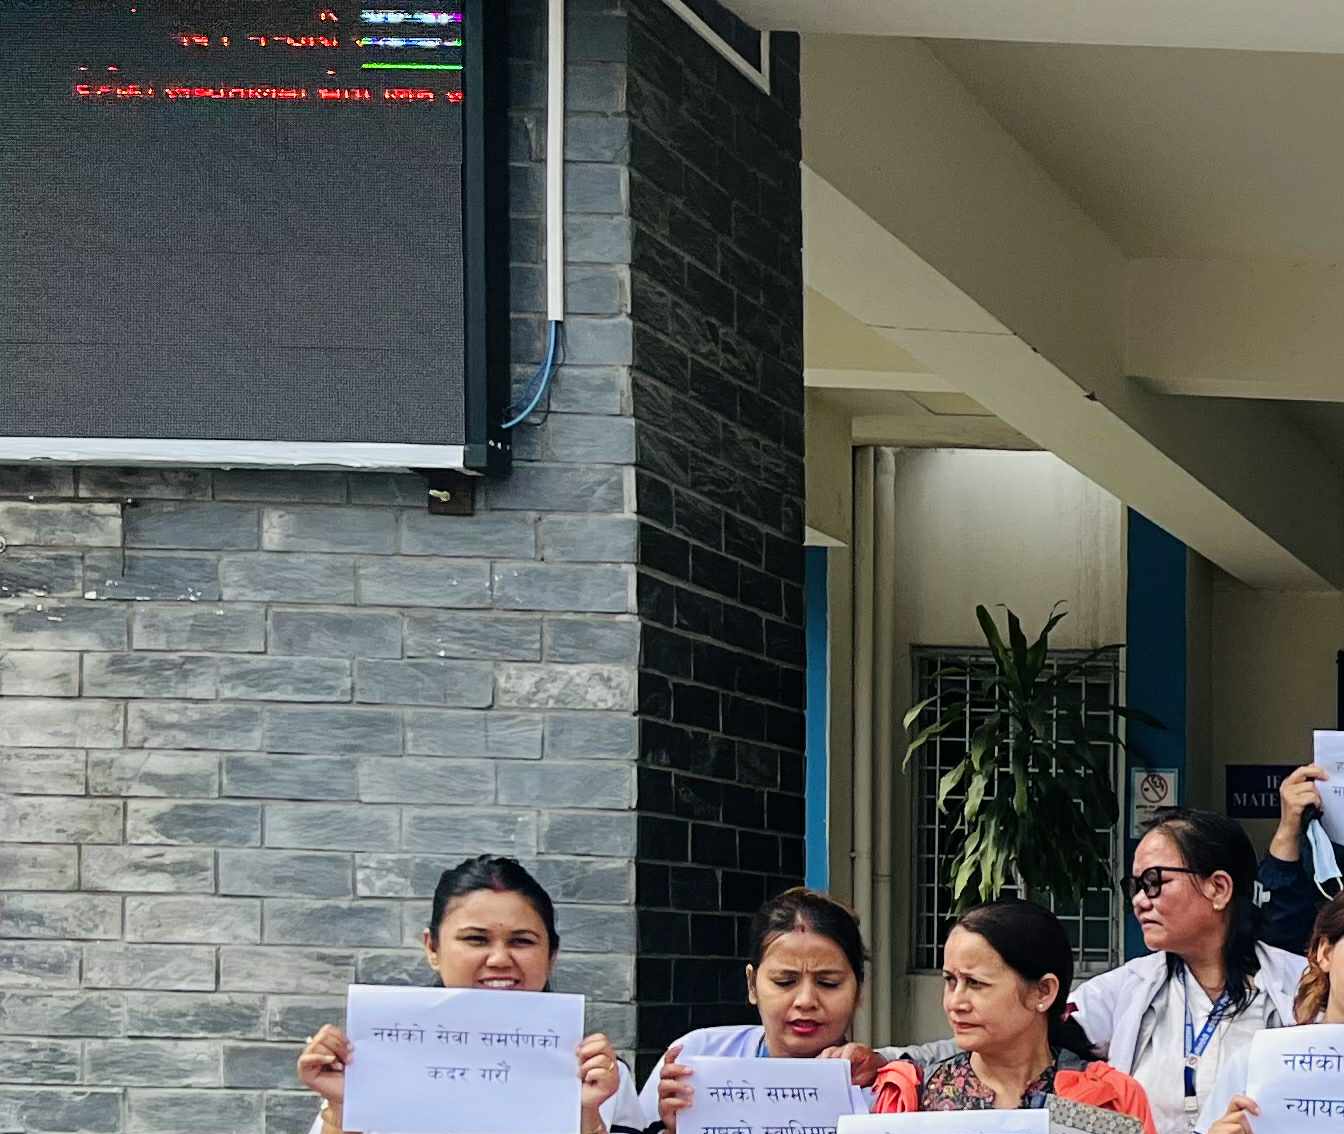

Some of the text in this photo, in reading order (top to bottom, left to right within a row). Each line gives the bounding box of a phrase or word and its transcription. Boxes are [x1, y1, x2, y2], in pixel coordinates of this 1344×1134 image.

[371, 1022, 561, 1049] नर्सको सेवा समर्पणको
[1281, 1045, 1344, 1073] नर्सको
[426, 1065, 471, 1081] कदर
[706, 1079, 819, 1105] नर्सको सम्मान
